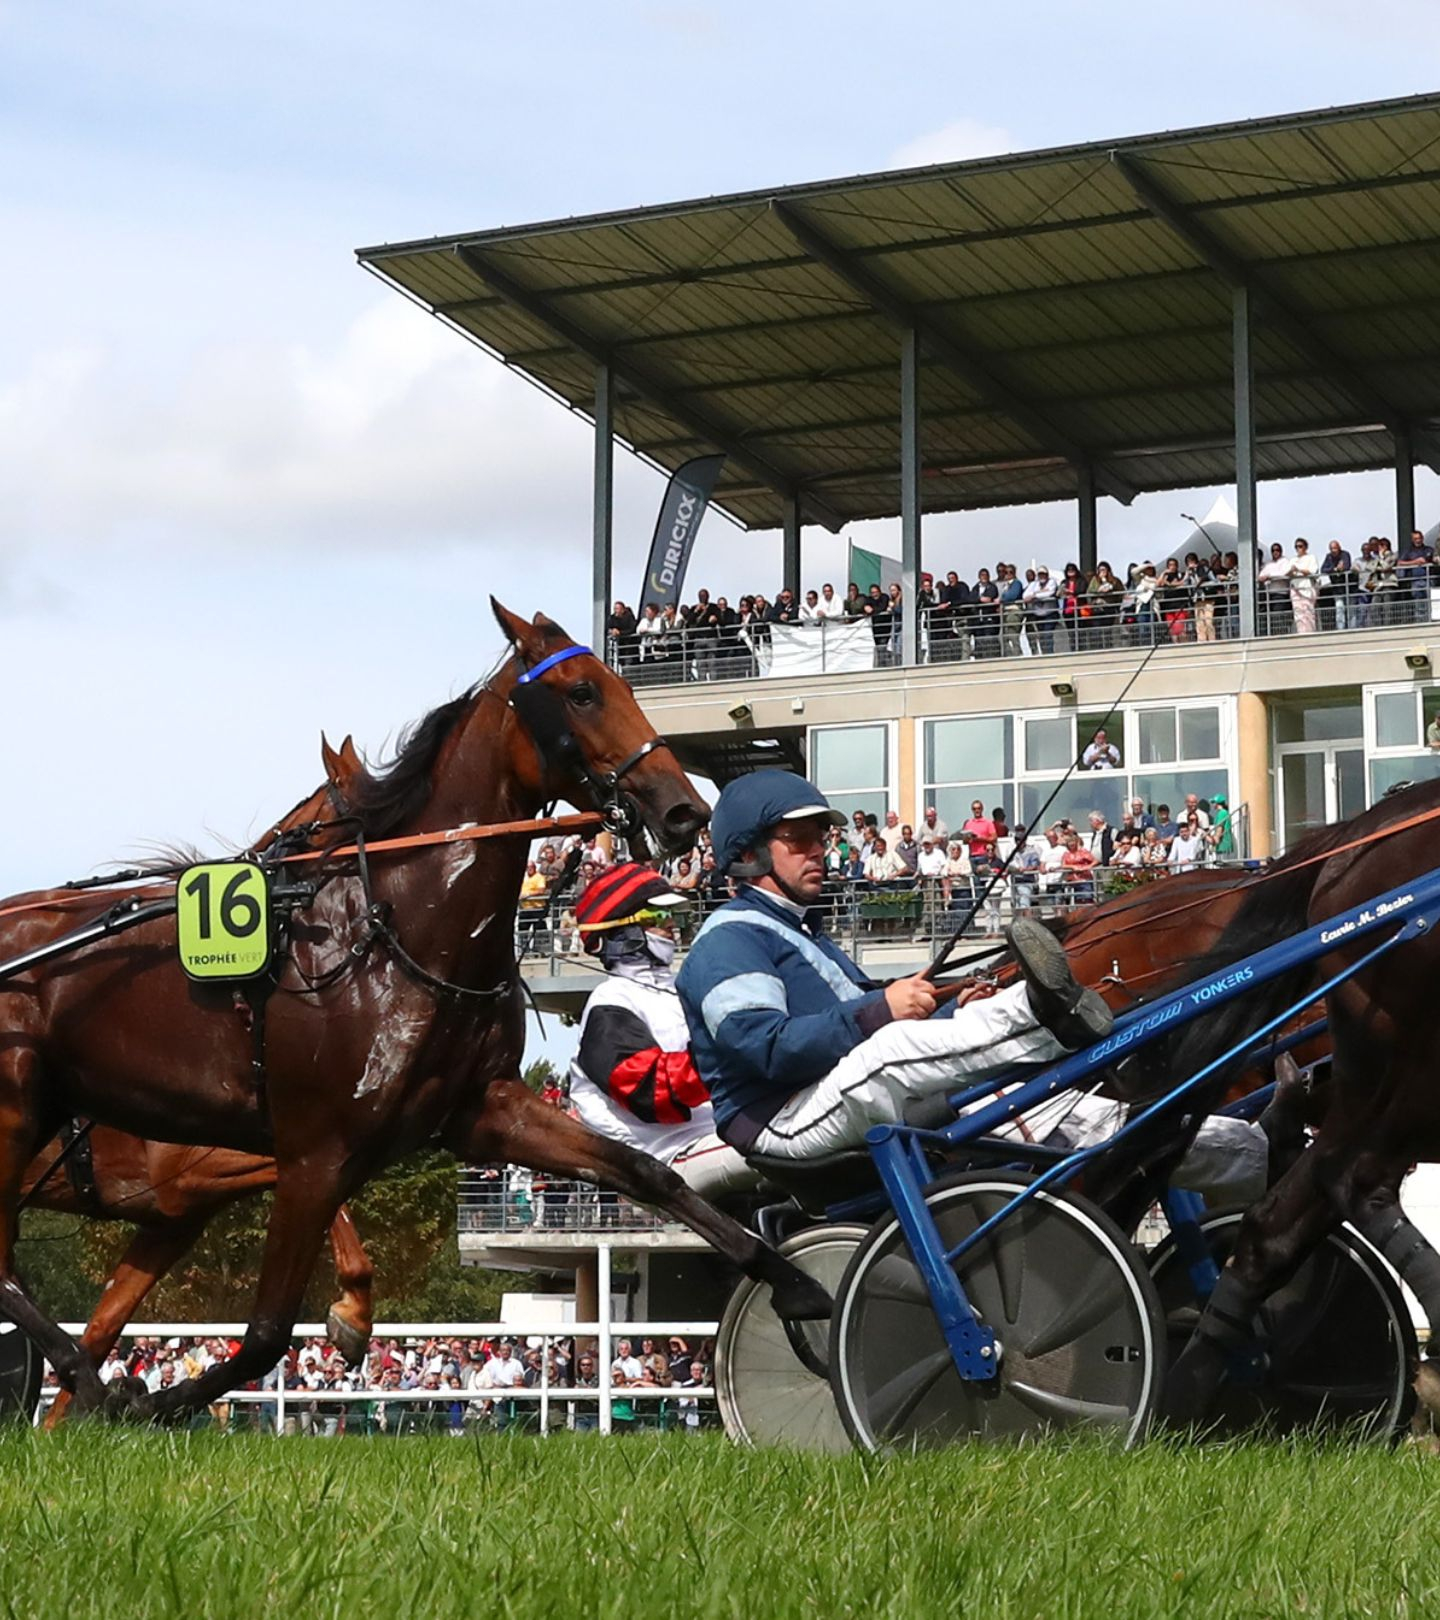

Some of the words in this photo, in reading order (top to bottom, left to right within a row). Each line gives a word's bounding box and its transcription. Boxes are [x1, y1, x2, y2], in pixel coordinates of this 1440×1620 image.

[660, 493, 697, 586] DIRICKX
[185, 868, 261, 939] 16
[188, 951, 237, 966] TROPHÉE
[240, 951, 262, 963] VERT
[1087, 1000, 1183, 1064] CUSTOM
[1191, 966, 1254, 1005] YONKERS
